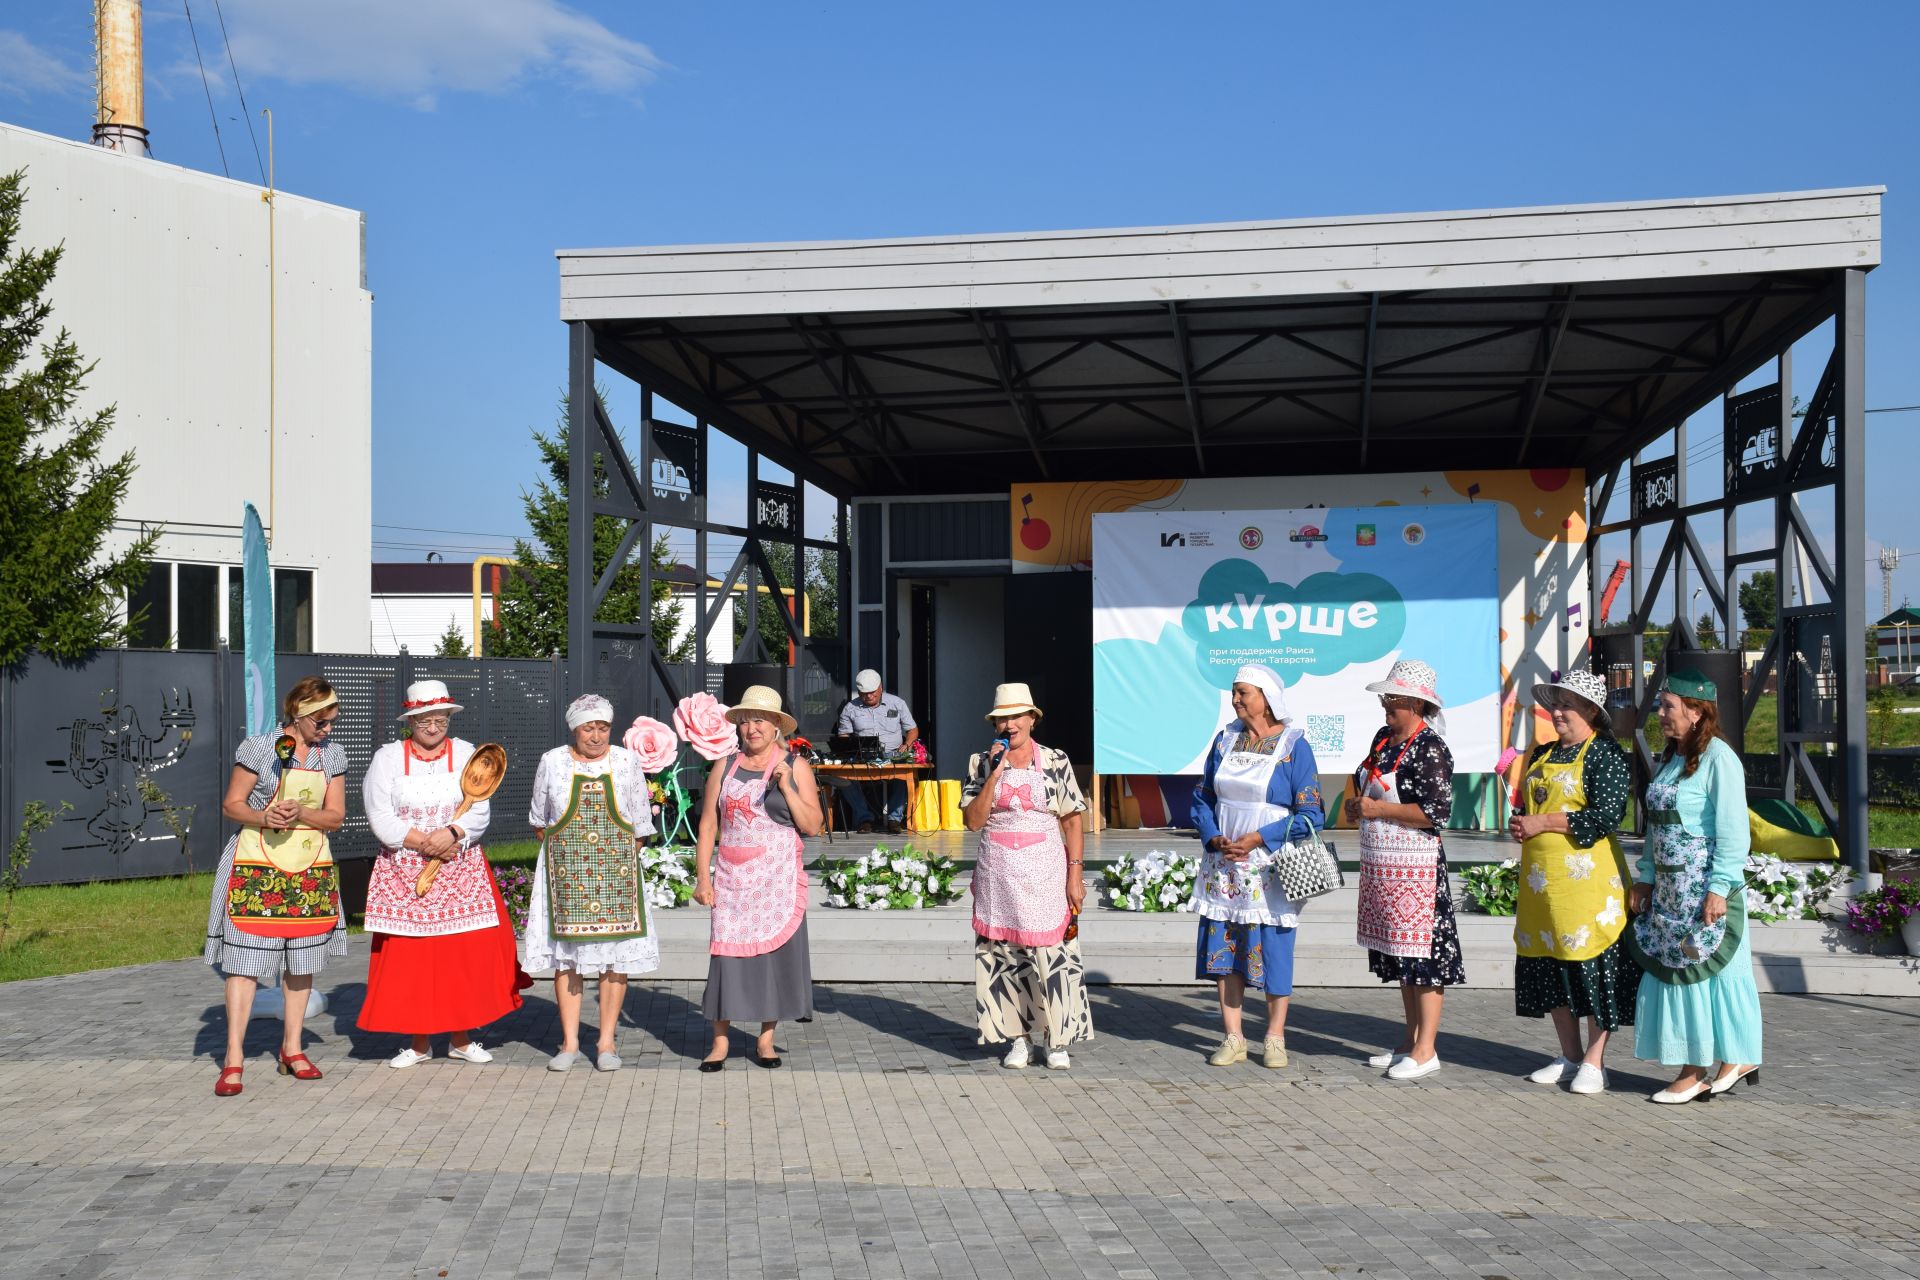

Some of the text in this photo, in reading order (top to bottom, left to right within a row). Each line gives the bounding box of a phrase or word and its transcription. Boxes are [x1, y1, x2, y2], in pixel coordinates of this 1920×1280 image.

[1209, 646, 1314, 657] при поддержке Раиса
[1209, 656, 1316, 666] Республики Татарстан
